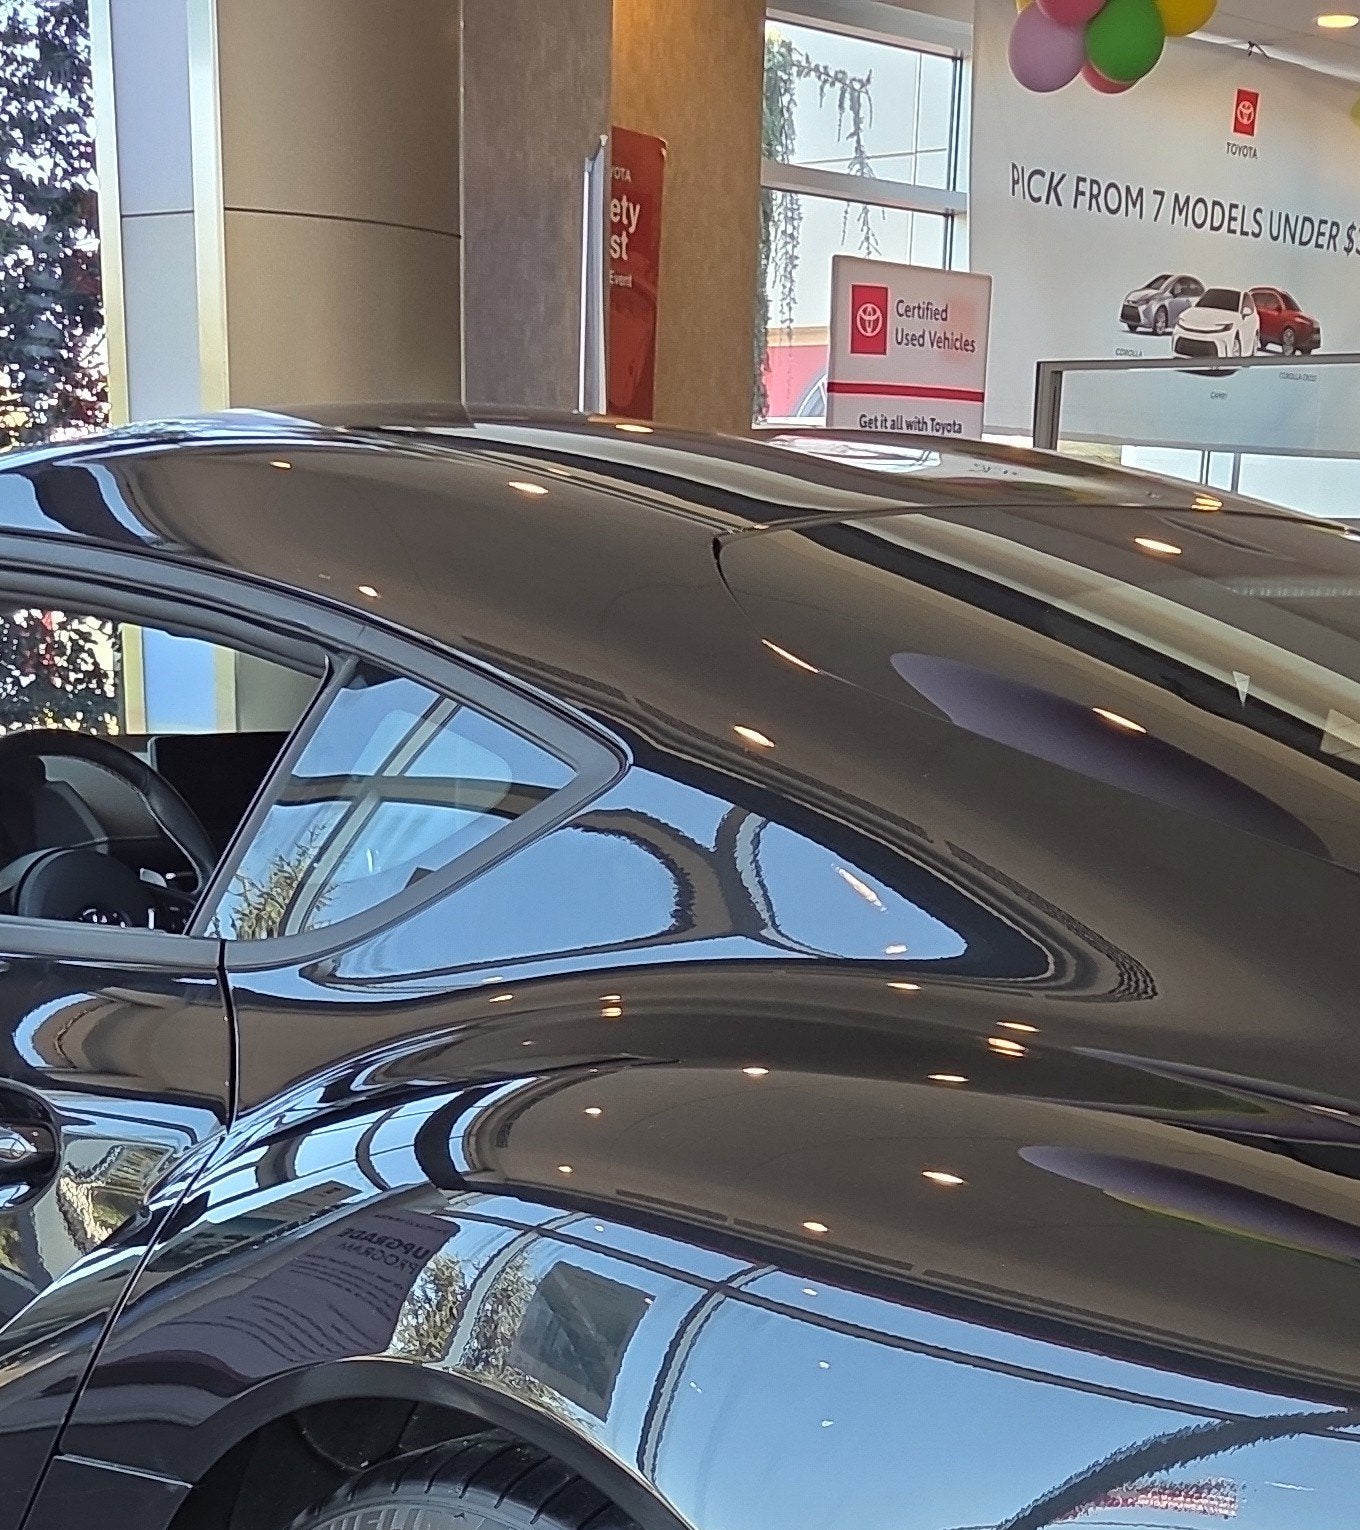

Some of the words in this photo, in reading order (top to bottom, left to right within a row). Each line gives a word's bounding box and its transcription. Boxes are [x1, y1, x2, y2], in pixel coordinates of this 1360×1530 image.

[1226, 141, 1258, 159] TOYOTA
[611, 166, 632, 182] OTA
[1010, 162, 1067, 206] PICK
[1073, 176, 1144, 221] FROM
[1152, 190, 1165, 222] 7
[1171, 192, 1264, 239] MODELS
[1269, 211, 1340, 252] UNDER
[896, 299, 949, 322] Certified
[895, 327, 926, 348] Used
[929, 330, 976, 353] Vehicles
[859, 413, 879, 430] Get
[880, 414, 888, 430] it
[890, 415, 903, 431] all
[905, 415, 928, 432] with
[930, 417, 963, 435] Toyota
